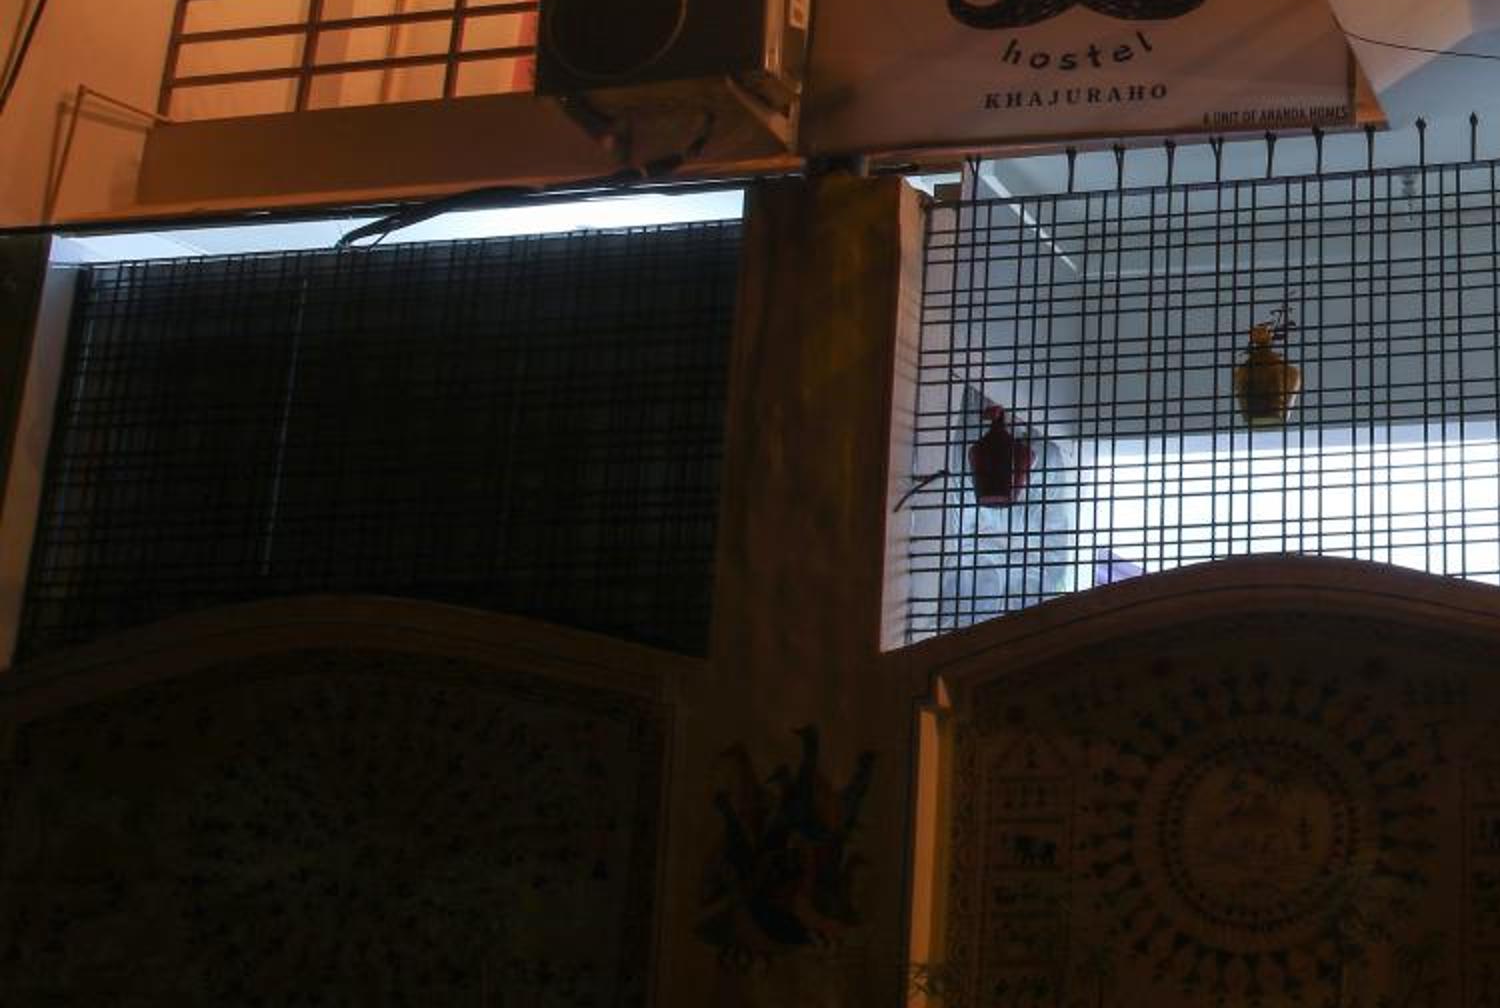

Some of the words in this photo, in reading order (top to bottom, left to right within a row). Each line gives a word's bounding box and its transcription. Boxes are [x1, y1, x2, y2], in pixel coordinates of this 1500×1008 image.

[1002, 31, 1153, 71] hostel
[984, 84, 1168, 109] KHAJURAHO
[1213, 110, 1238, 124] UNIT
[1242, 109, 1256, 122] OF
[1309, 105, 1346, 121] HOMES
